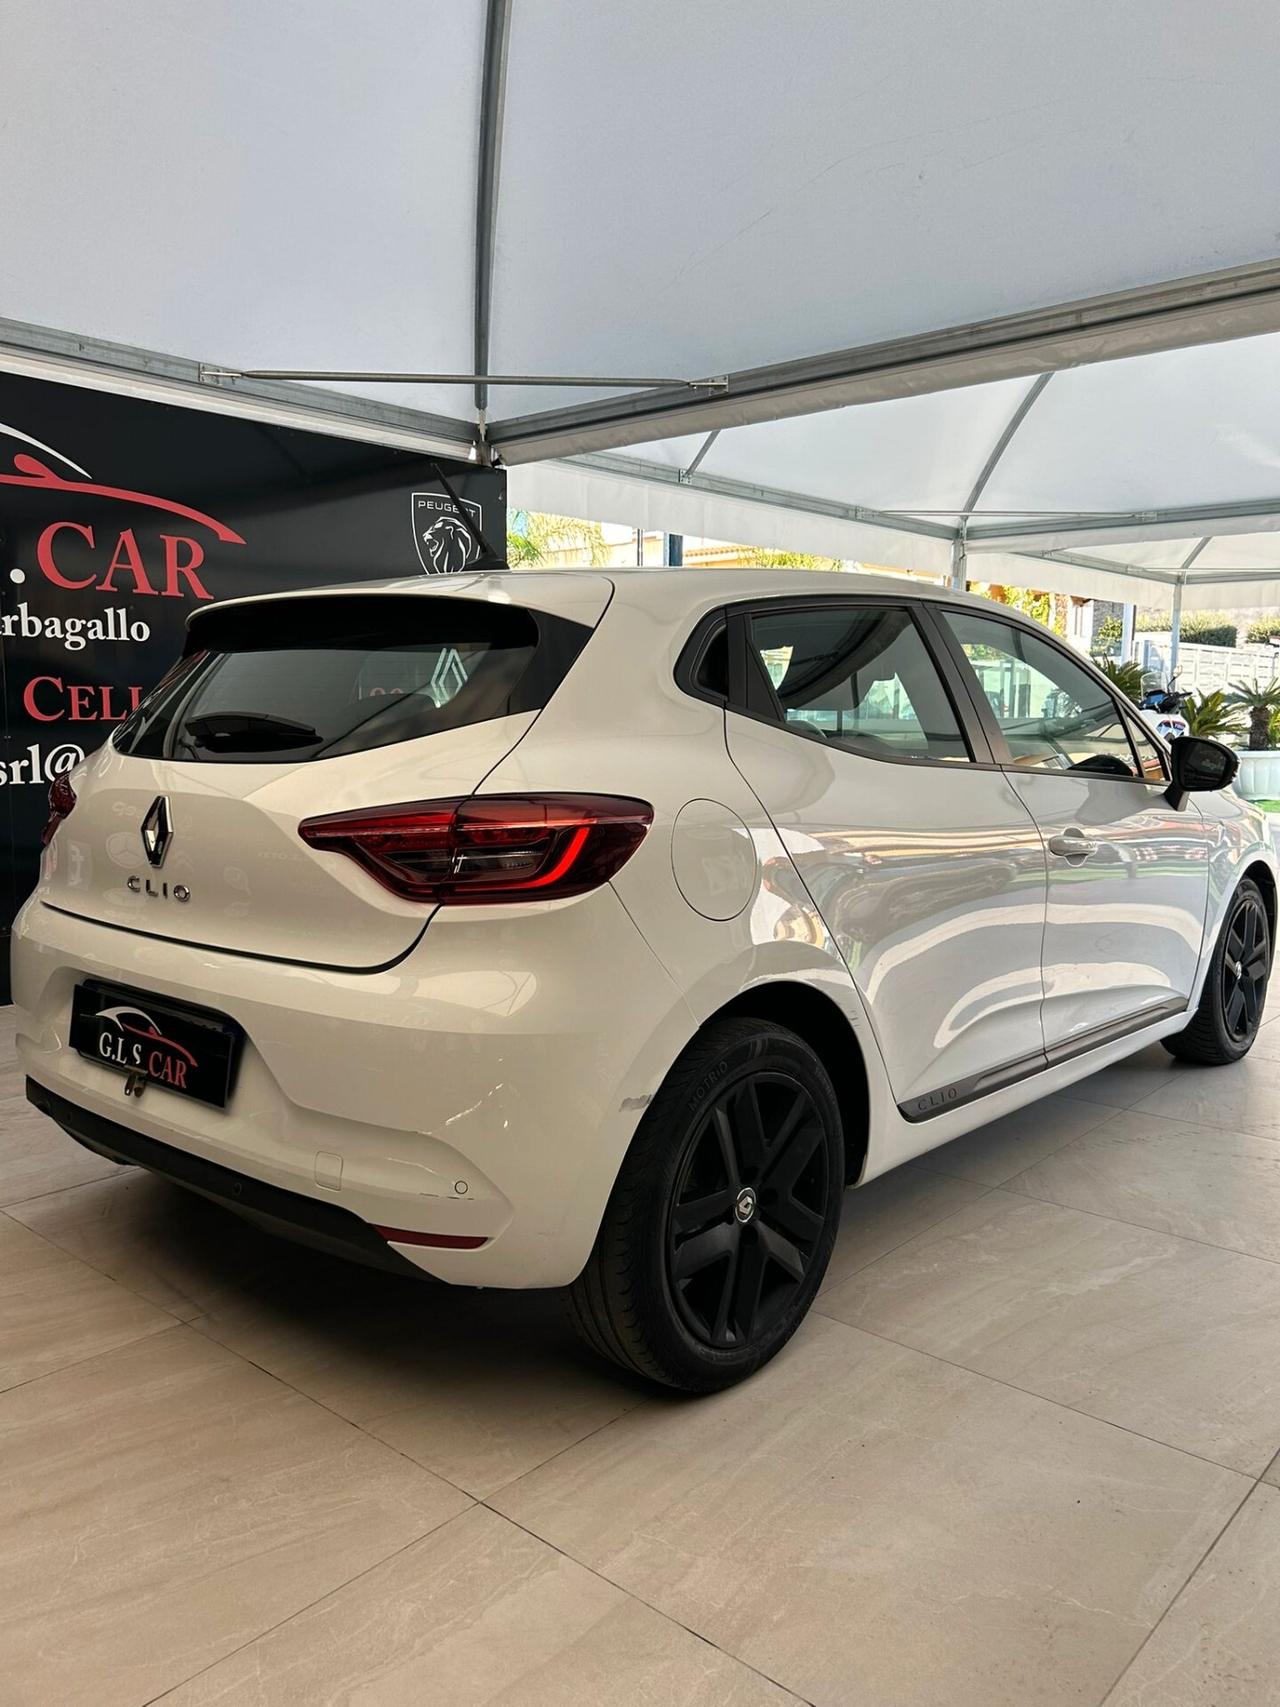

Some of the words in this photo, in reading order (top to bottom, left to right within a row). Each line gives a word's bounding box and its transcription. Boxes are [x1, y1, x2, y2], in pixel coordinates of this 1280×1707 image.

[418, 500, 476, 518] PEUGET
[37, 521, 215, 600] CAR
[0, 602, 151, 651] rbagallo
[127, 875, 191, 902] CLIO
[149, 1051, 187, 1089] CAR
[688, 1060, 729, 1112] MOTRIO
[917, 1087, 958, 1111] CLIO
